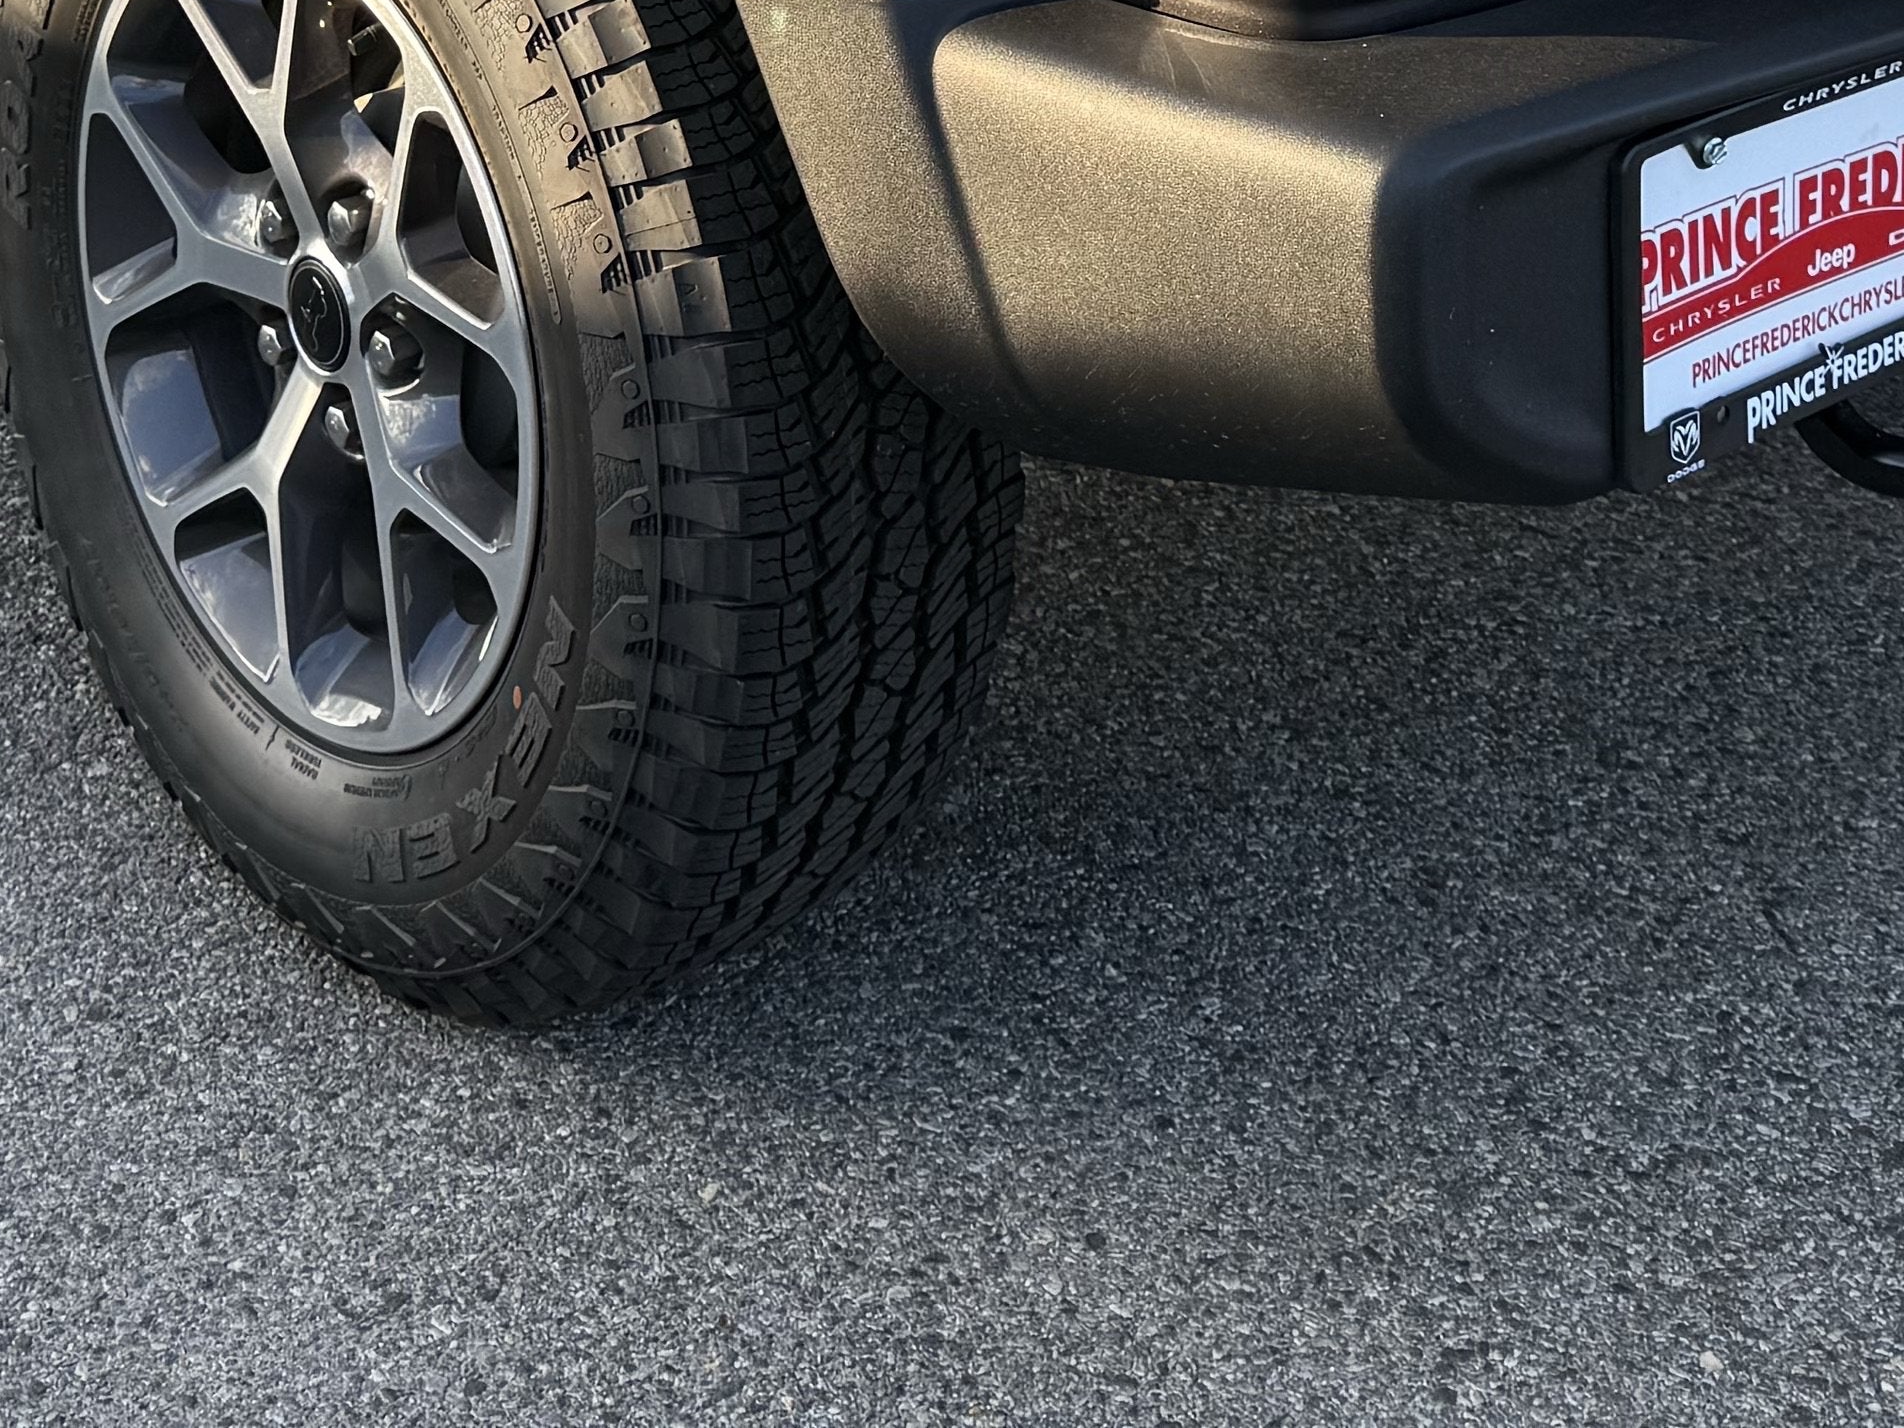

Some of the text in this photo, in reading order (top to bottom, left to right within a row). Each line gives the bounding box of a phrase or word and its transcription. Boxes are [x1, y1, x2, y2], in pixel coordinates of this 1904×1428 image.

[1782, 60, 1903, 112] CHRYSLER
[1641, 187, 1780, 310] PRINCE
[1652, 277, 1782, 343] CHRYSLER
[1807, 243, 1856, 275] Jeep
[1746, 366, 1827, 445] PRINCE
[1667, 458, 1706, 483] DODGE
